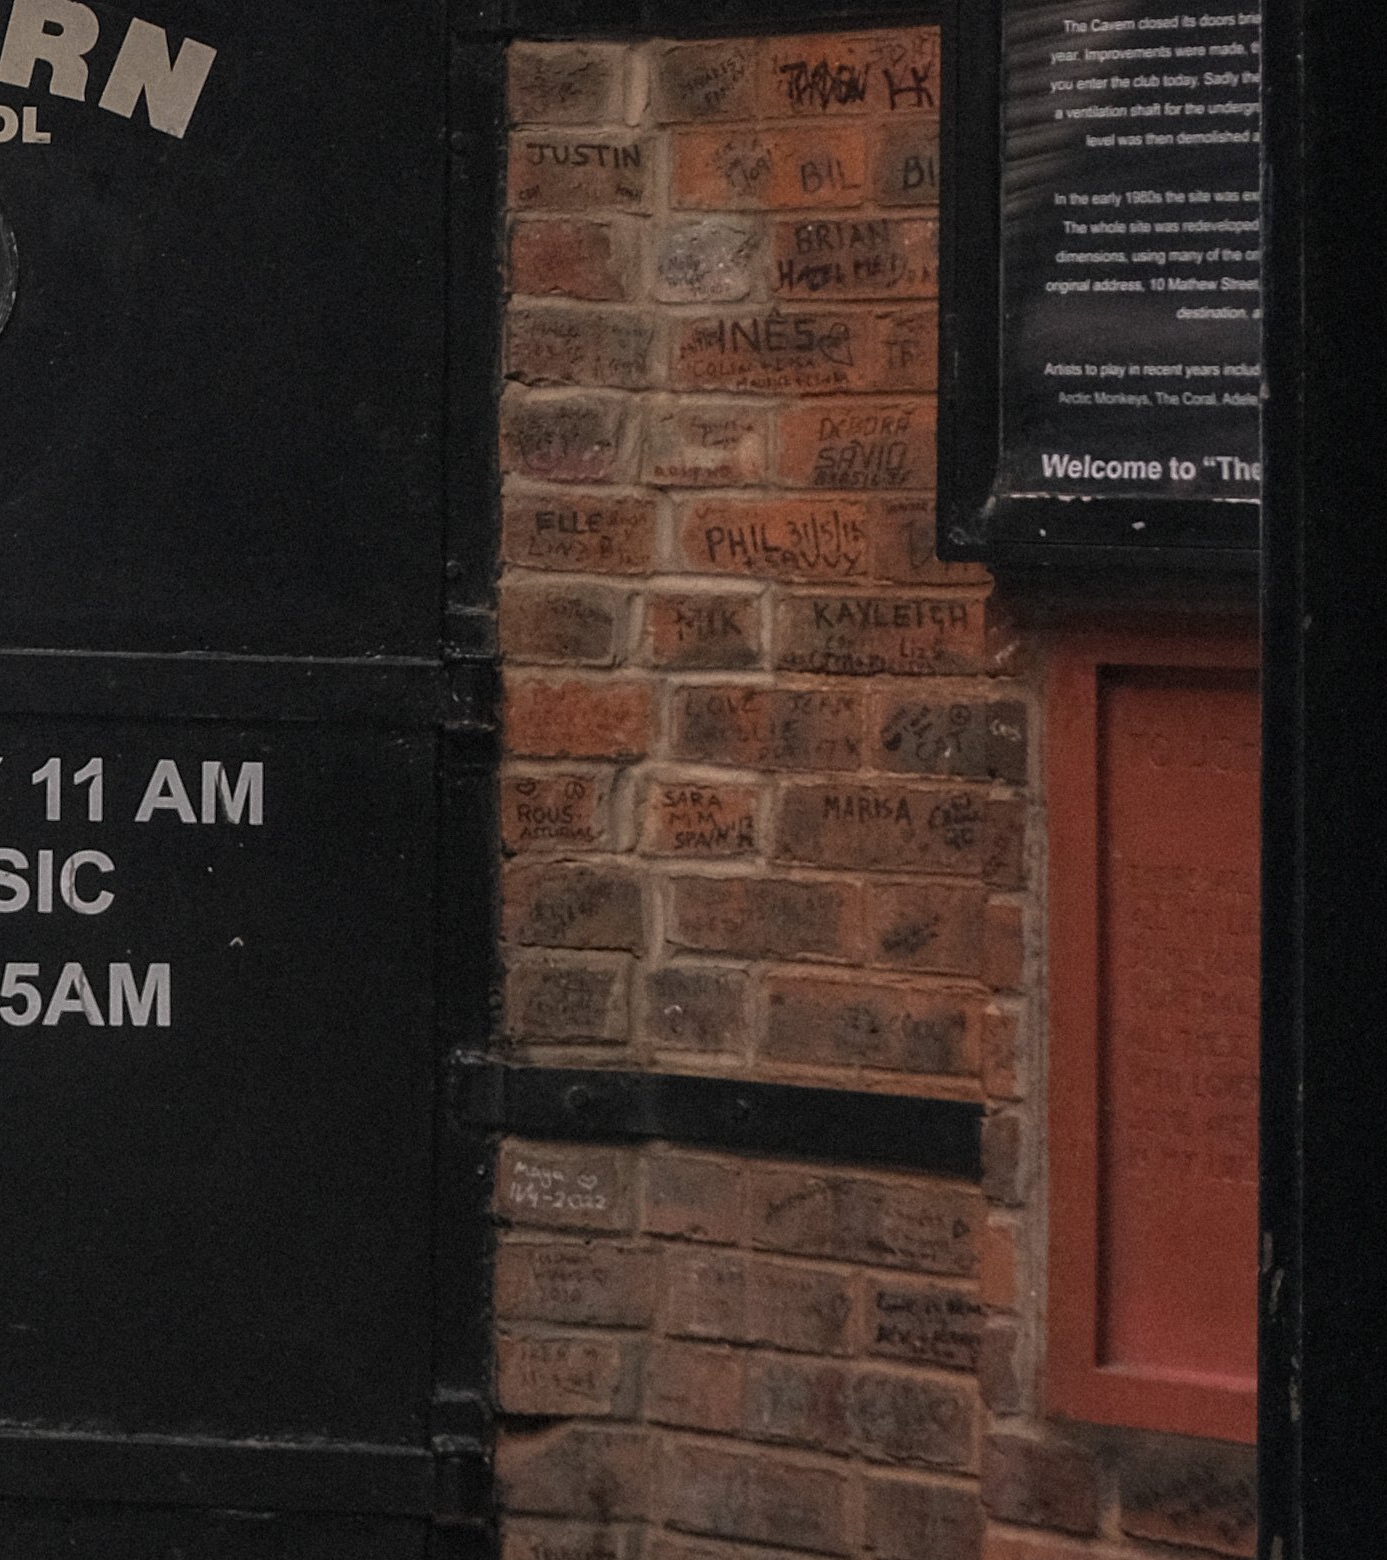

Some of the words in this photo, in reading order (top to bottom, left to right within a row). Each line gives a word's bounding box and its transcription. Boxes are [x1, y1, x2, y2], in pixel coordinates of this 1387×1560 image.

[1064, 20, 1087, 32] The
[1090, 19, 1135, 31] Cavern
[1137, 16, 1178, 30] closed
[1199, 13, 1236, 27] doors
[1085, 46, 1172, 63] Improvements
[1175, 46, 1206, 57] were
[1050, 80, 1074, 94] you
[1077, 79, 1107, 90] enter
[1110, 76, 1130, 88] the
[1133, 75, 1160, 87] club
[1203, 72, 1240, 87] Sadly
[1176, 131, 1250, 144] demolished
[526, 142, 641, 169] JUSTIN
[1070, 193, 1089, 205] the
[1165, 190, 1186, 204] the
[1063, 220, 1087, 233] The
[1046, 278, 1091, 294] original
[1044, 362, 1082, 376] Artists
[1084, 364, 1097, 376] to
[1099, 364, 1126, 378] play
[1128, 363, 1140, 375] in
[1142, 364, 1183, 376] recent
[1185, 364, 1220, 379] years
[1155, 391, 1179, 404] The
[1041, 454, 1163, 480] Welcome
[1169, 456, 1197, 480] to
[30, 756, 106, 823] 11
[135, 759, 265, 826] AM
